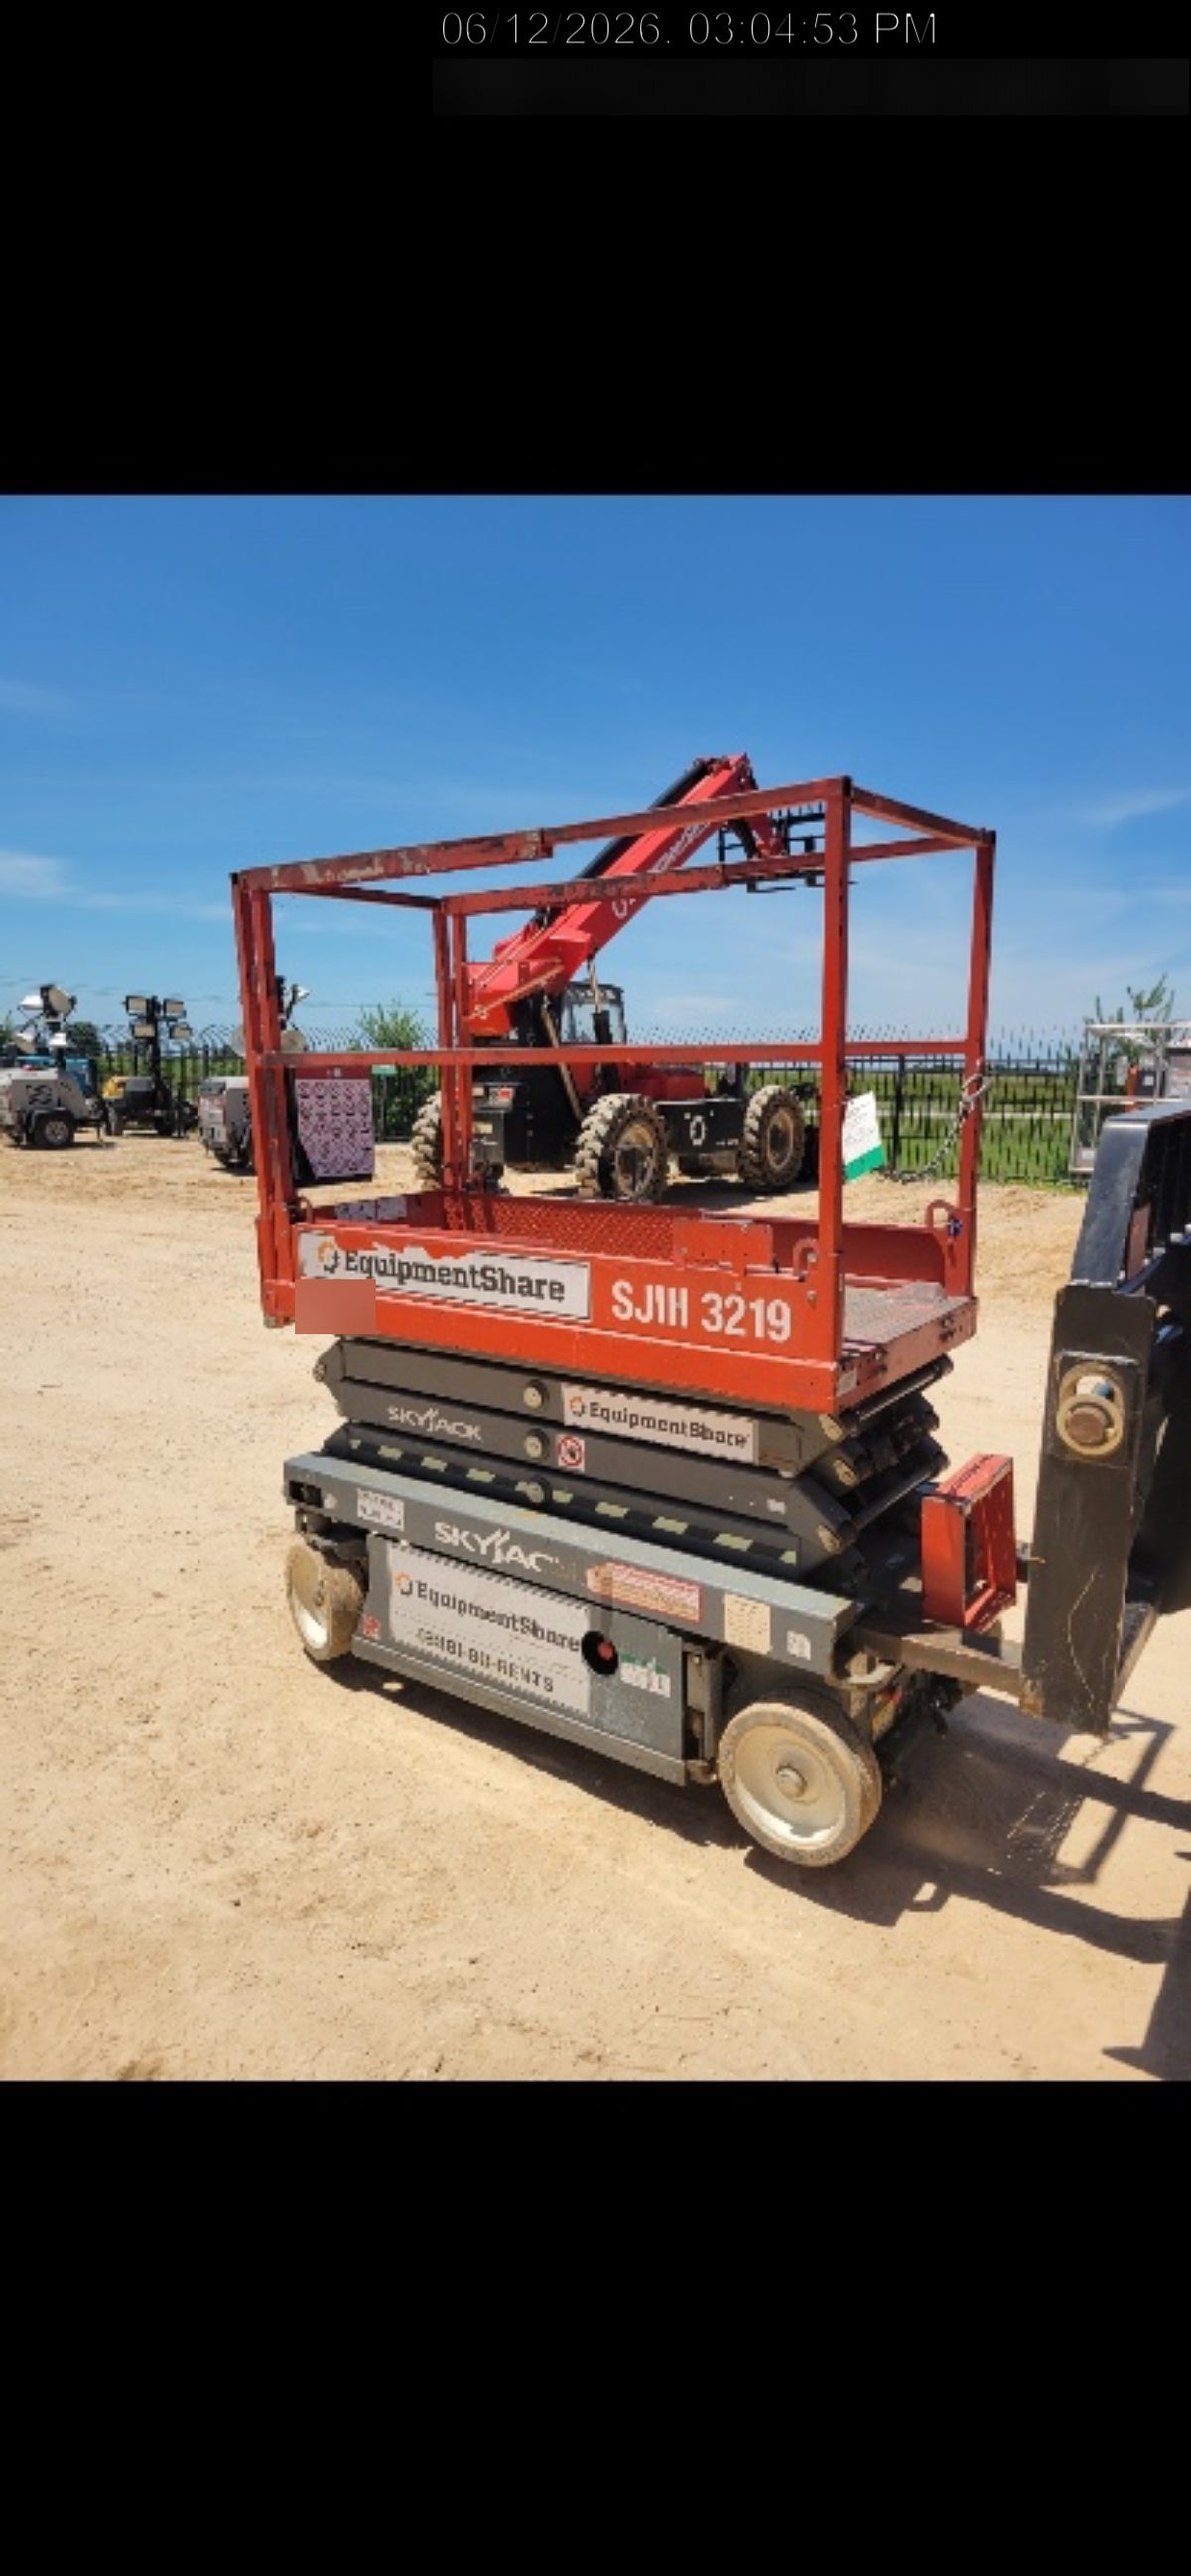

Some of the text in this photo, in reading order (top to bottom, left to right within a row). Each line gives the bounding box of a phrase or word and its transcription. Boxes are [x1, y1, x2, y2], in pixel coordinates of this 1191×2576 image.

[345, 1249, 566, 1303] EquipmentShare
[701, 1292, 792, 1343] 3219
[387, 1405, 484, 1442] SKYJACK
[589, 1401, 749, 1448] EquipmentShare
[434, 1520, 567, 1575] SKYJAC
[416, 1579, 580, 1652] EquipmentShare
